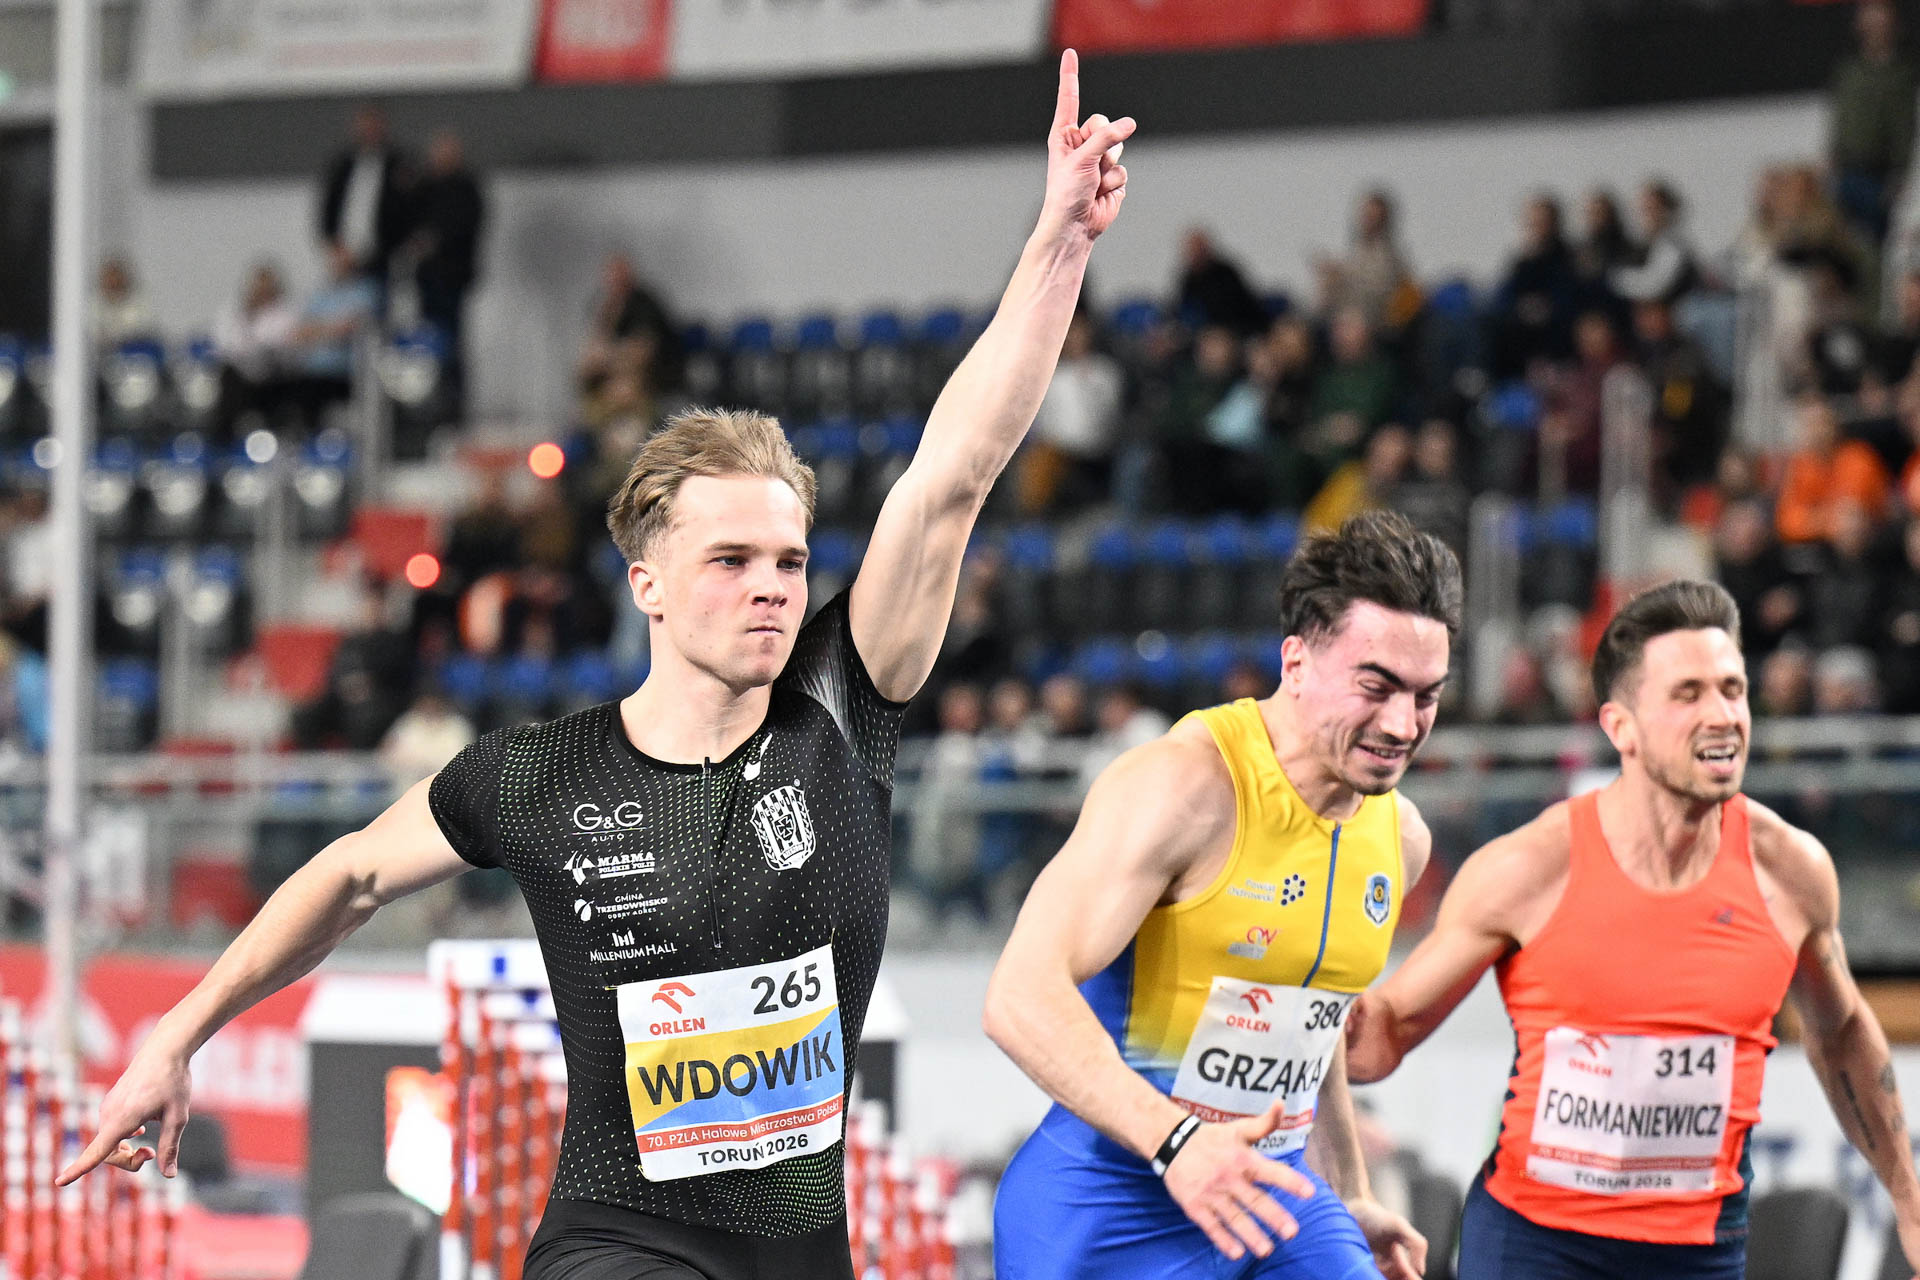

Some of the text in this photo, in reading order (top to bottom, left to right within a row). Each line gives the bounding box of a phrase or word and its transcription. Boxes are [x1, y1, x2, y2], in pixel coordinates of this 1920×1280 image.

[573, 801, 643, 830] G&G
[591, 833, 624, 842] AUTO
[597, 852, 656, 867] MARMA
[595, 897, 668, 914] TRZEBOWNISKO
[615, 892, 644, 903] GMINA
[750, 962, 821, 1015] 265
[649, 1017, 705, 1036] ORLEN
[1226, 1014, 1272, 1033] ORLEN
[637, 1031, 837, 1106] WDOWIK
[1568, 1058, 1612, 1078] ORLEN
[1655, 1046, 1716, 1078] 314
[647, 1101, 839, 1148] 70. PZLA Halowe Mistrzostwa Polski
[1543, 1088, 1723, 1138] FORMANIEWICZ
[697, 1134, 809, 1166] TORUŃ 2026
